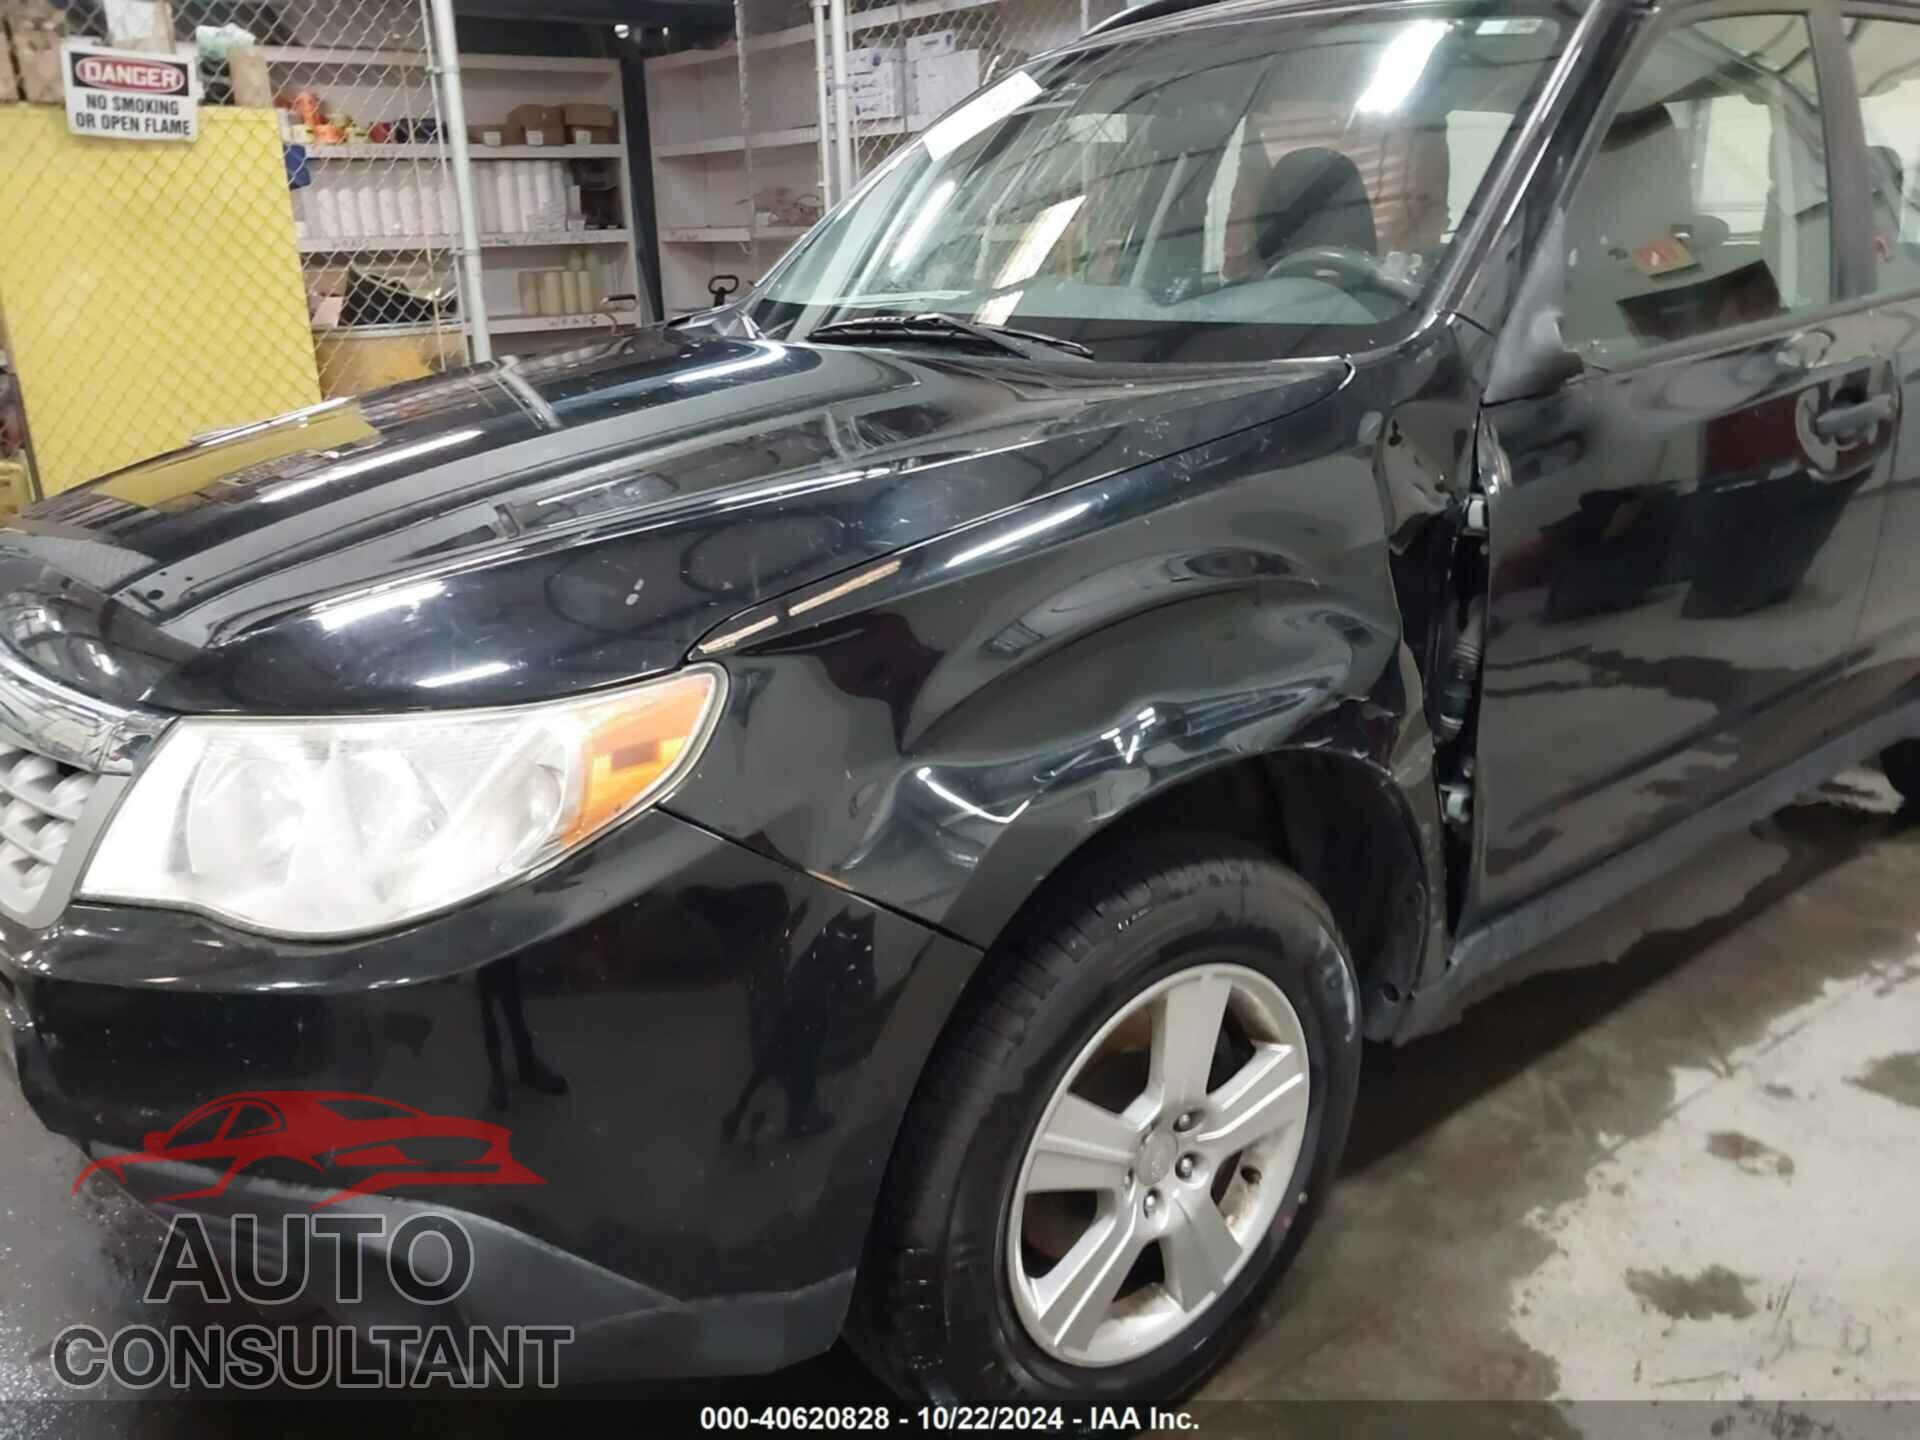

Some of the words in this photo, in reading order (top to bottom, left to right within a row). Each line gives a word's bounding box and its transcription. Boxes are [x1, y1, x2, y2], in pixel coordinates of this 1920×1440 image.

[83, 61, 179, 88] DANGER
[86, 94, 107, 110] NO
[112, 96, 179, 116] SMOKING
[76, 112, 96, 129] OR
[102, 114, 140, 133] OPEN
[144, 118, 191, 136] FLAME
